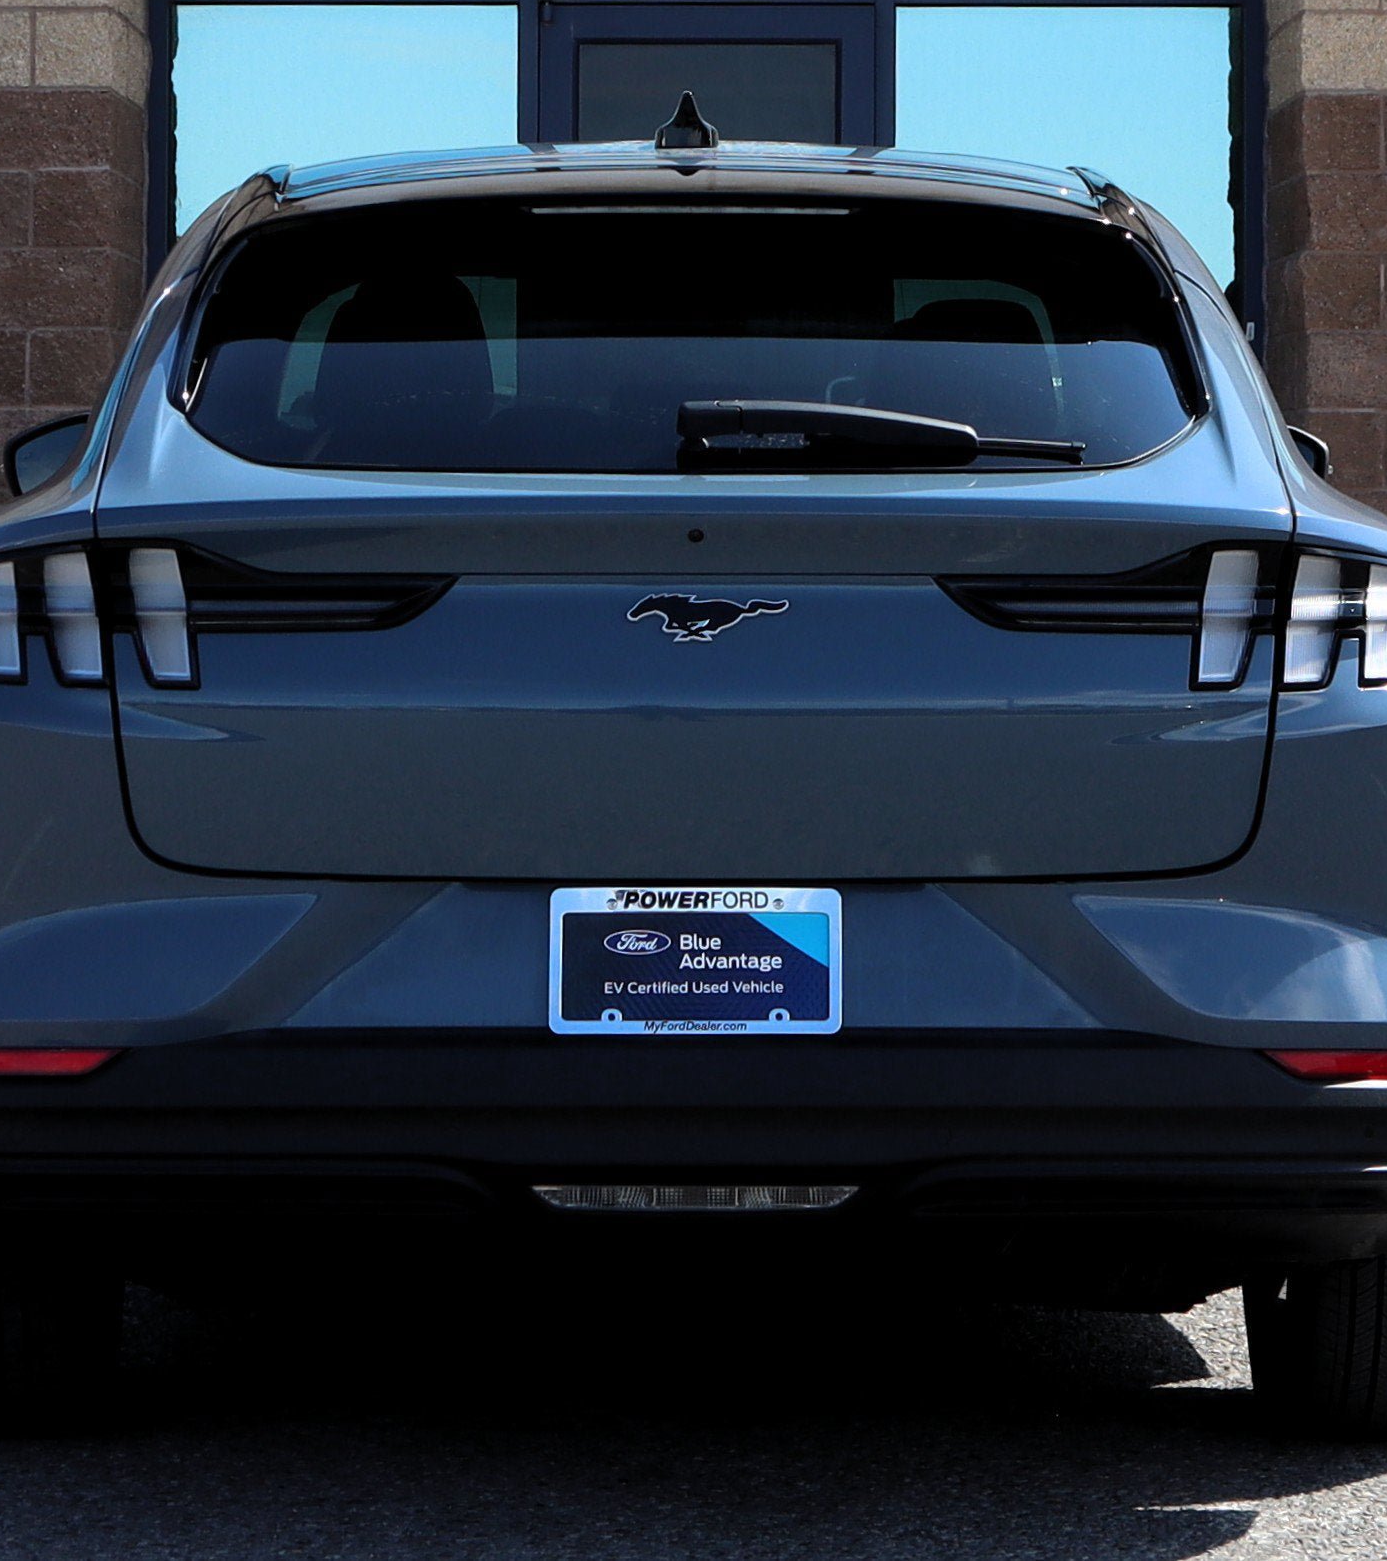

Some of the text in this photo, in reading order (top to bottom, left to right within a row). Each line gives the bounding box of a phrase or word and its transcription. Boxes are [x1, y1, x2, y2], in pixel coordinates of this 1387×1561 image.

[616, 934, 658, 951] Ford
[679, 934, 722, 950] Blue
[679, 953, 783, 971] Advantage
[604, 981, 784, 994] EV Certified Used Vehicle
[644, 1021, 747, 1034] MyFordDealer.com
